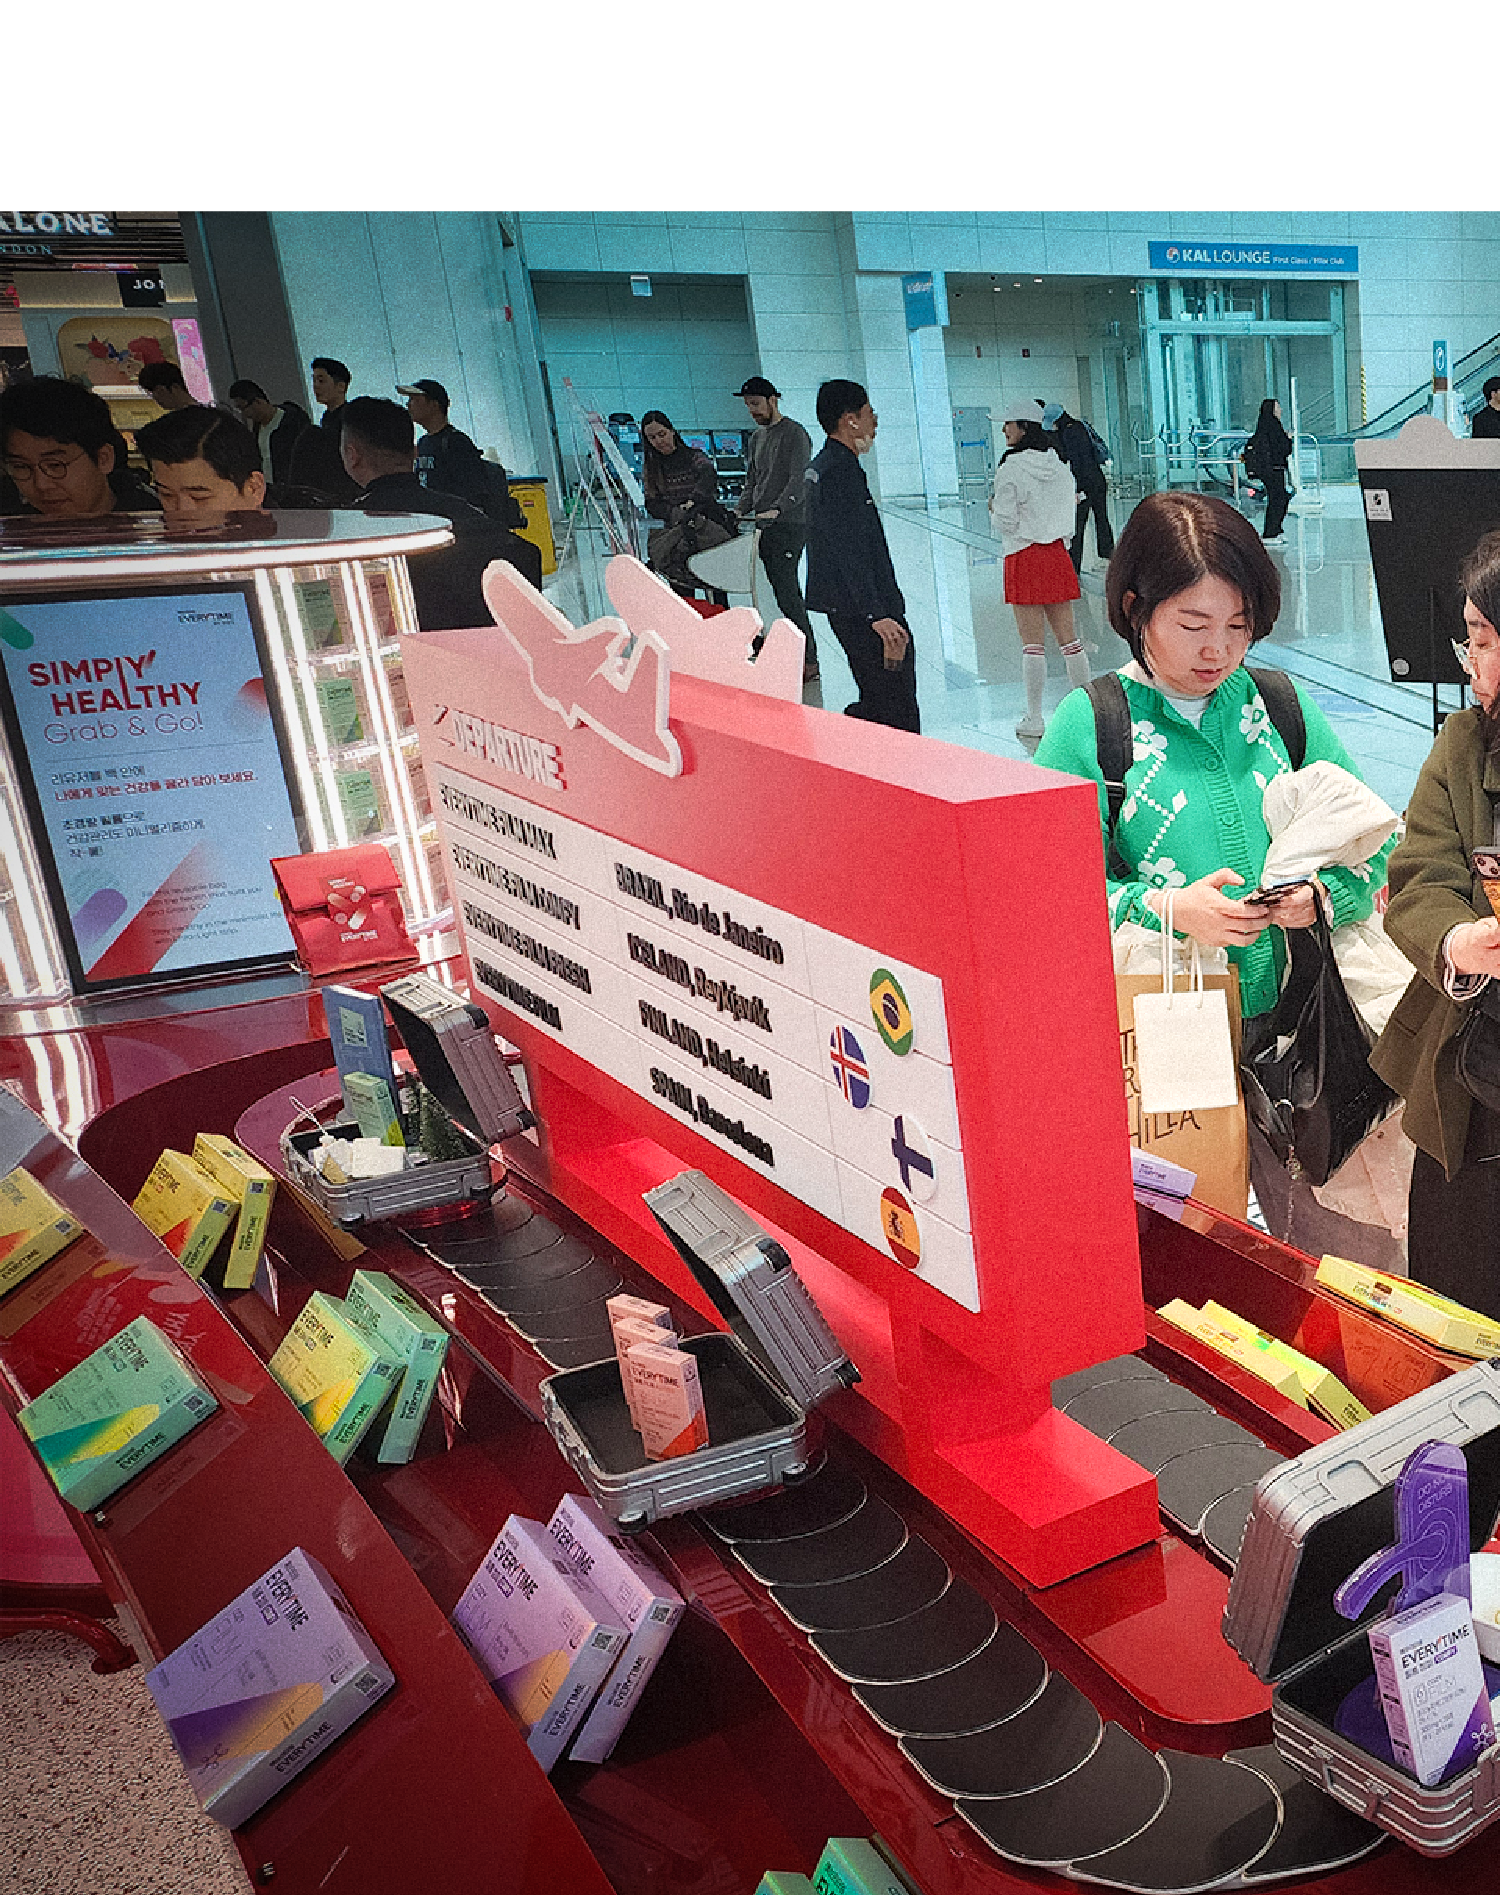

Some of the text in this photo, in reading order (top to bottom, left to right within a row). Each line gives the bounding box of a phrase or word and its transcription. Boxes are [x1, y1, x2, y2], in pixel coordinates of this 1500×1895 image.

[1182, 249, 1212, 262] KAL
[1213, 249, 1271, 264] LOUNGE
[27, 649, 156, 689] SIMPLY
[51, 681, 201, 717] HEALTHY
[44, 711, 203, 744] Grab & Go!
[453, 708, 567, 791] DEPARTURE
[615, 863, 675, 919] BRAZIL,
[672, 887, 699, 925] Rio
[722, 911, 784, 965] Janeiro
[626, 932, 773, 1033] ICELAND, Reykjavik
[637, 999, 773, 1100] FINLAND, Helsinki
[1418, 1482, 1452, 1513] DISTURB
[493, 1539, 539, 1601] EVERYTIME
[549, 1517, 596, 1575] EVERYTIME
[265, 1568, 310, 1632] EVERYTIME
[1401, 1623, 1470, 1670] EVERYTIME
[613, 1654, 647, 1709] EVERYTIME
[548, 1682, 587, 1737] EVERYTIME
[275, 1720, 333, 1774] EVERYTIME
